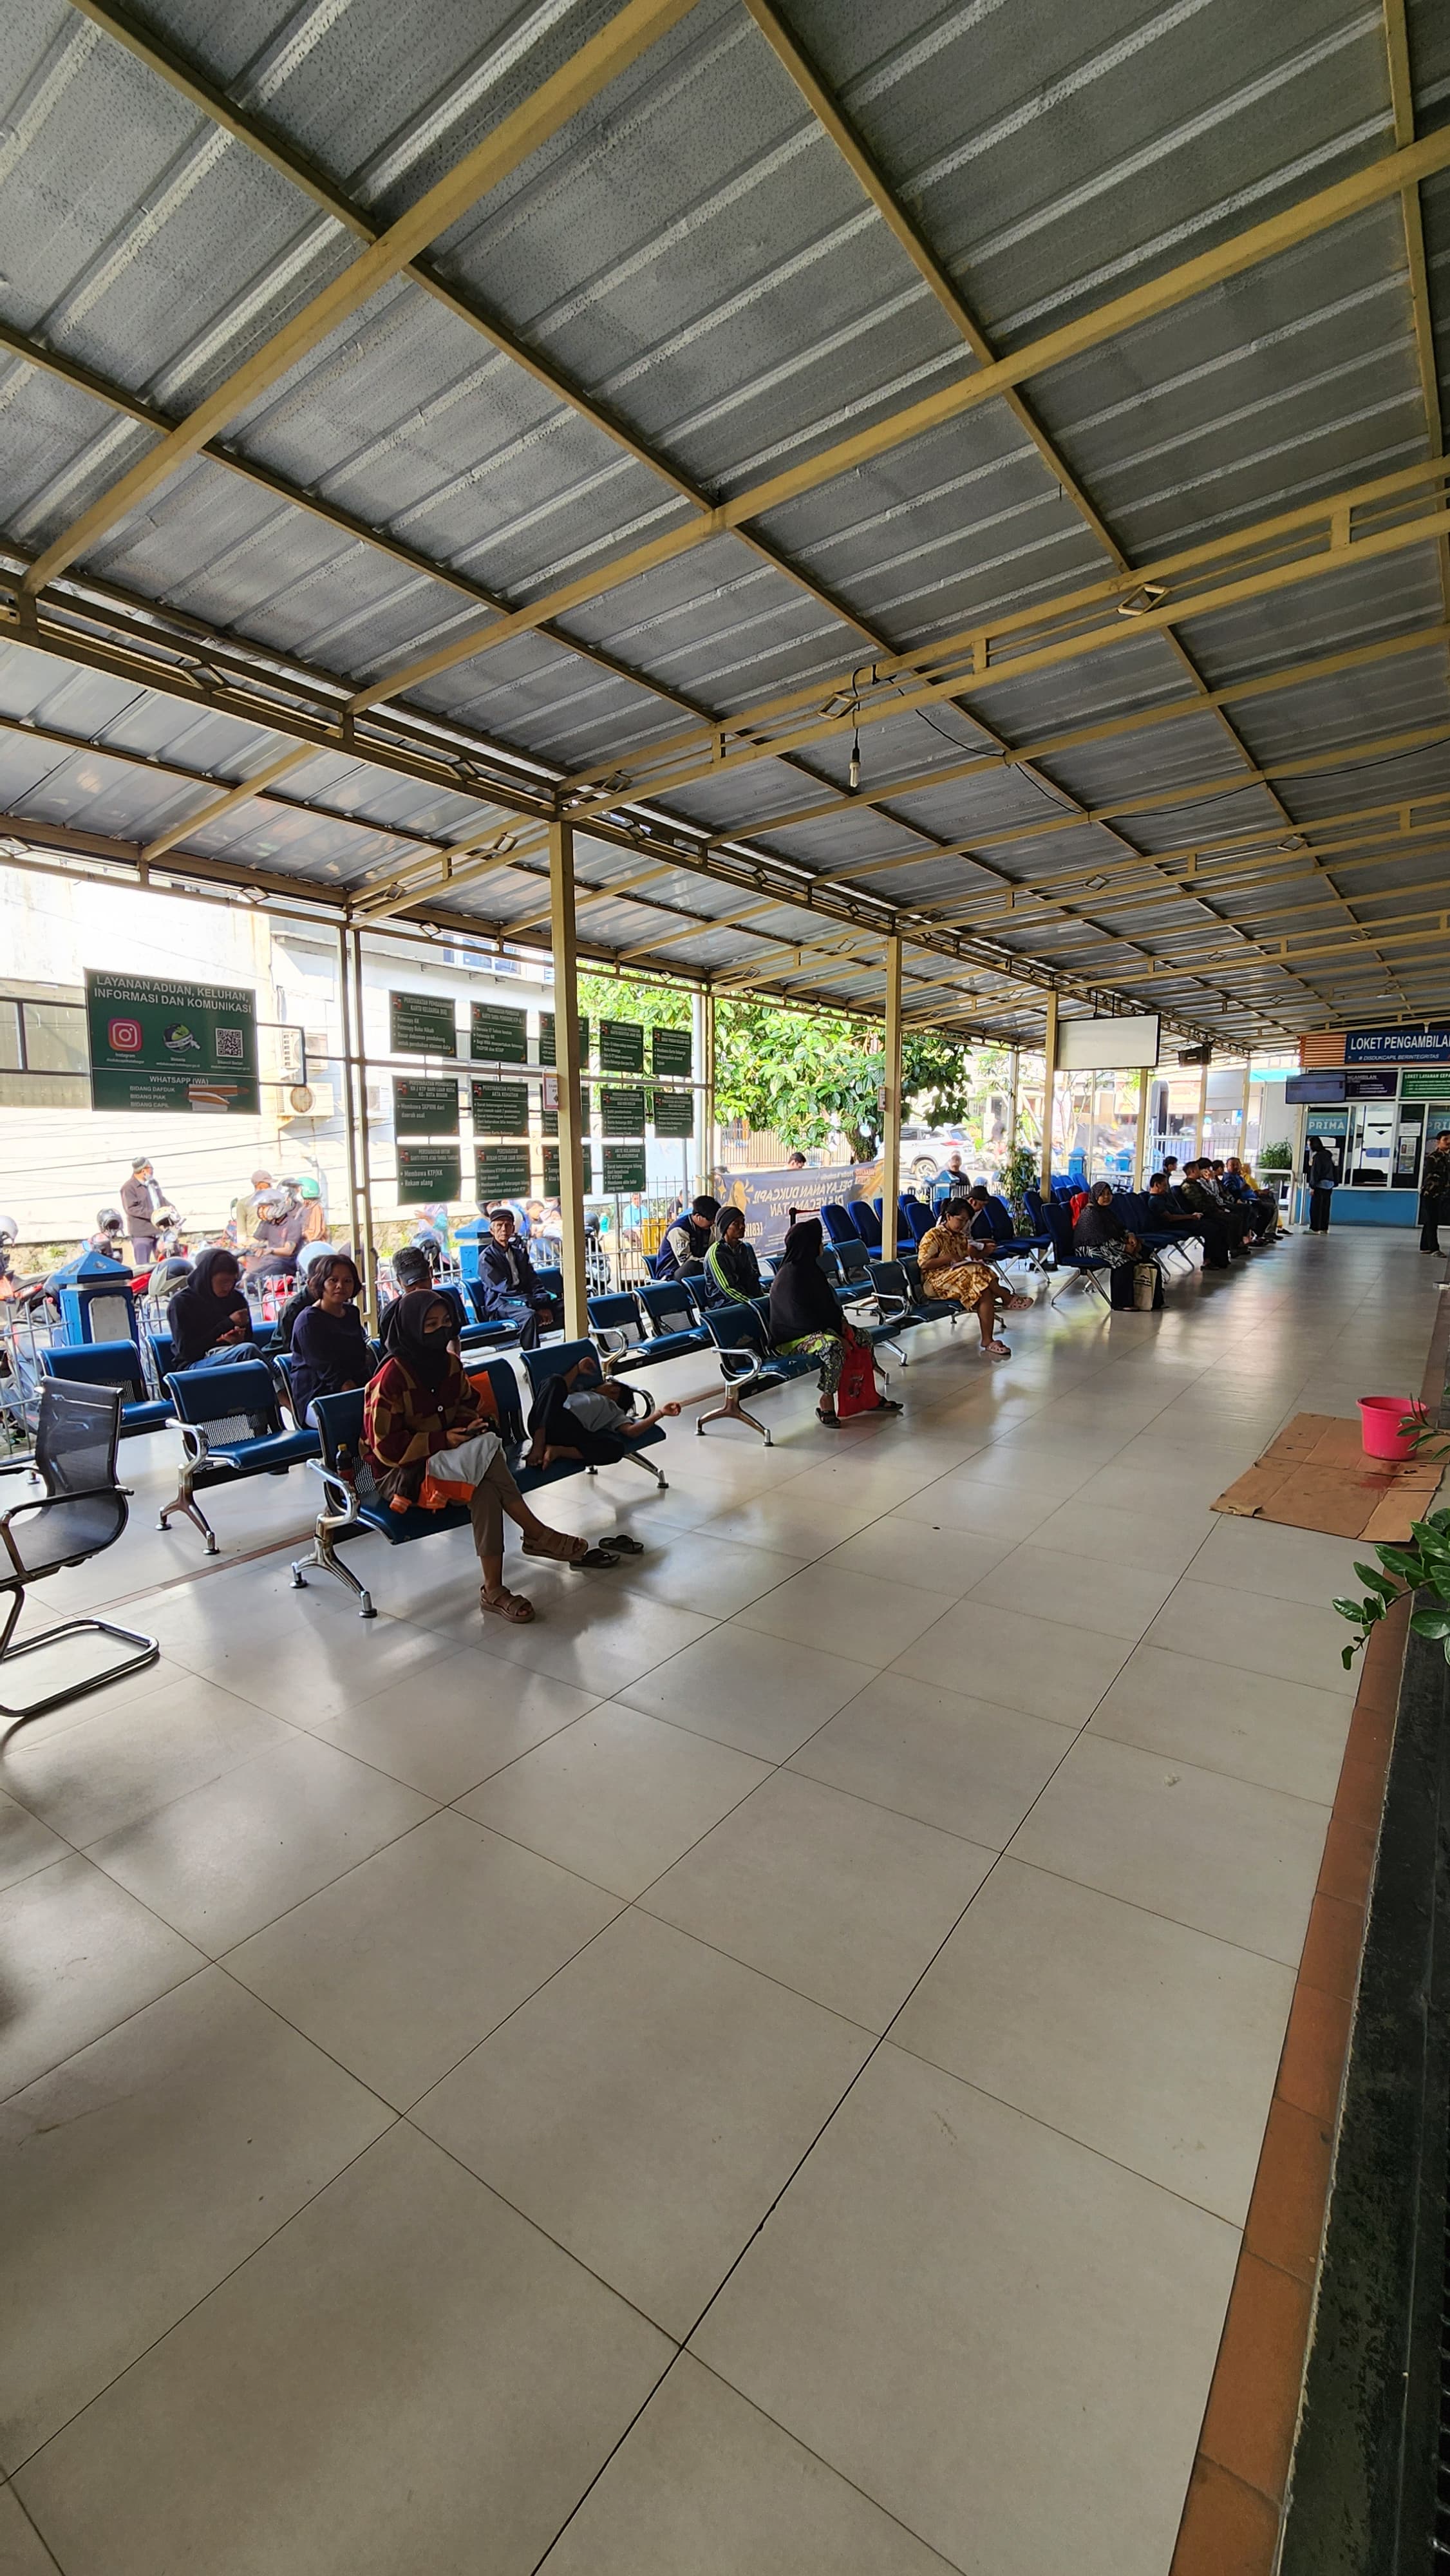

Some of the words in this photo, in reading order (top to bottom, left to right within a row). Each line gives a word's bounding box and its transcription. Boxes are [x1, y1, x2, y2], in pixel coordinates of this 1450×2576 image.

[97, 975, 150, 990] LAYANAN
[153, 983, 194, 996] ADUAN,
[197, 987, 249, 1003] KELUHAN,
[94, 988, 158, 1003] INFORMASI
[161, 996, 184, 1006] DAN
[187, 998, 251, 1013] KOMUNIKASI
[1351, 1037, 1382, 1050] LOKET
[149, 1075, 191, 1084] WHATSAPP
[1308, 1121, 1345, 1130] PRIMA
